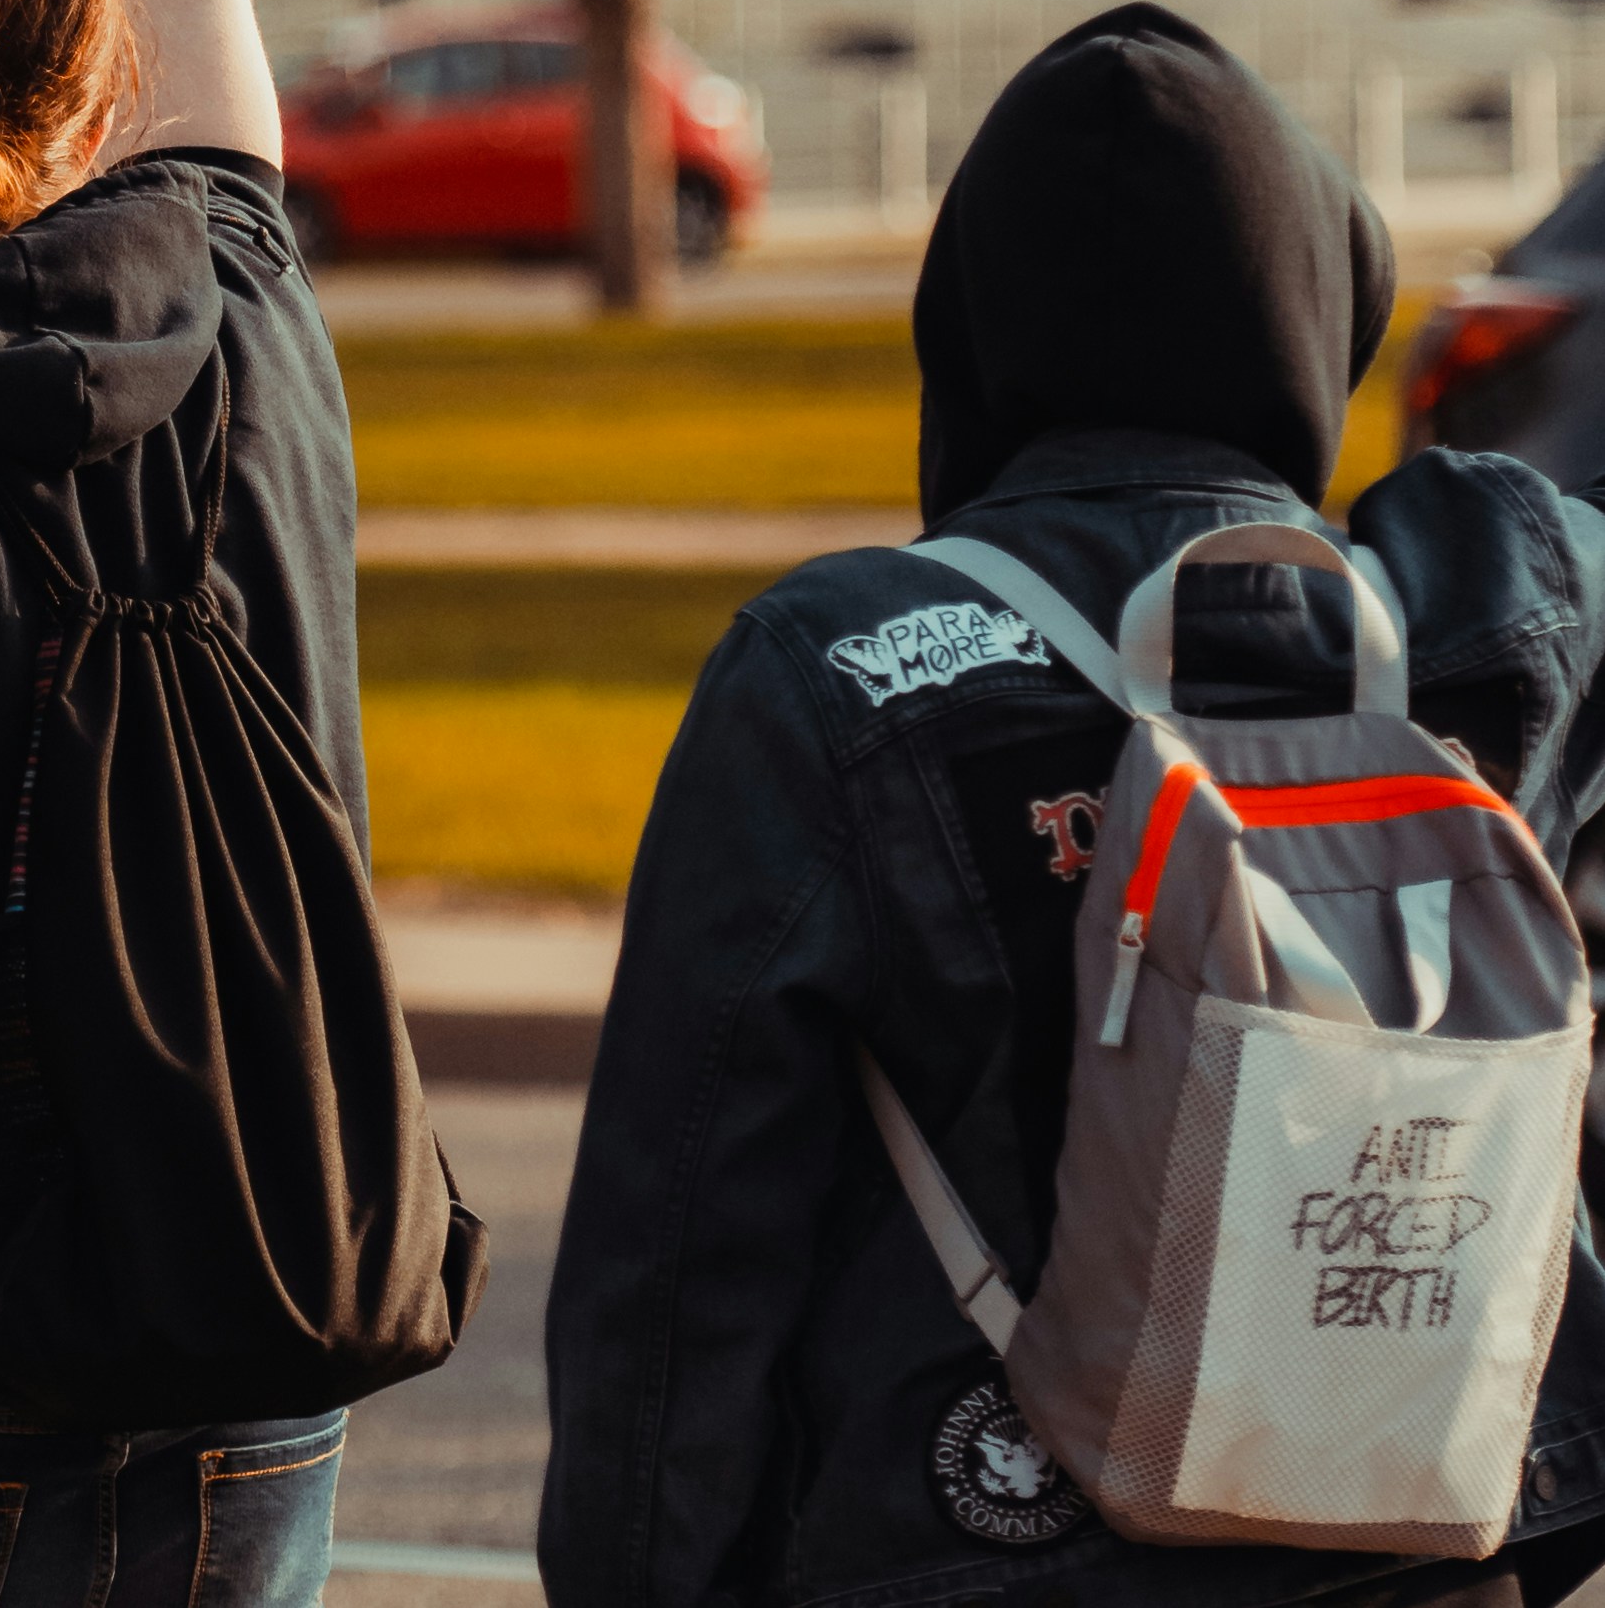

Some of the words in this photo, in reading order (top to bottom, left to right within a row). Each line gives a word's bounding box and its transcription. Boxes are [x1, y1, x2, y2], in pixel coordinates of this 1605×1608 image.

[887, 608, 990, 654] PARA
[1351, 1116, 1470, 1185] ANTI
[1290, 1190, 1492, 1257] FORCED
[1313, 1265, 1459, 1331] BIRTH
[935, 1384, 996, 1478] JOHNNY
